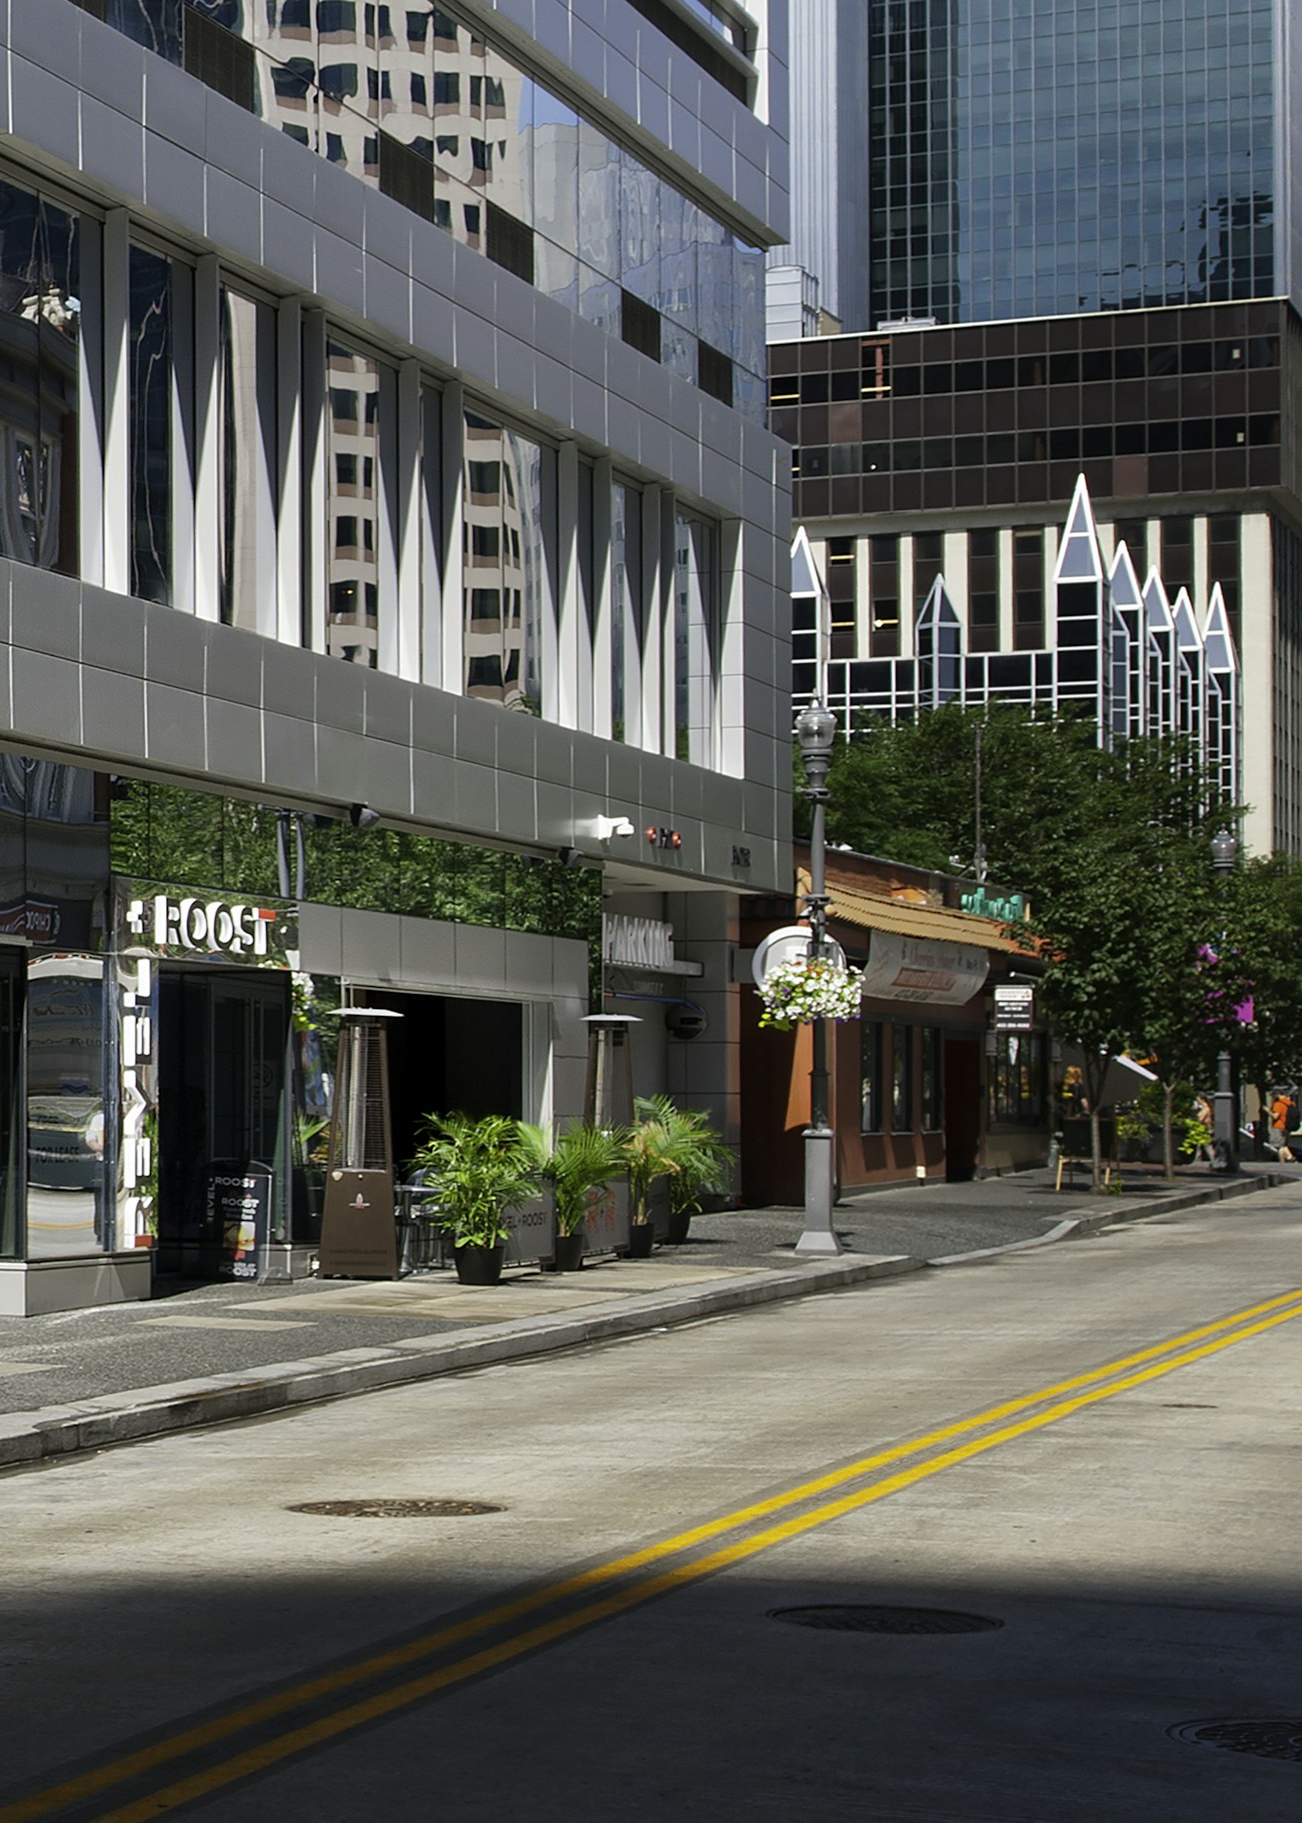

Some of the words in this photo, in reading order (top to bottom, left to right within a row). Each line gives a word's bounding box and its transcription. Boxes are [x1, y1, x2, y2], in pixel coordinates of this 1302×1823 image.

[155, 895, 276, 955] ROOST
[602, 912, 675, 967] PARKING
[214, 1176, 257, 1188] ROOST
